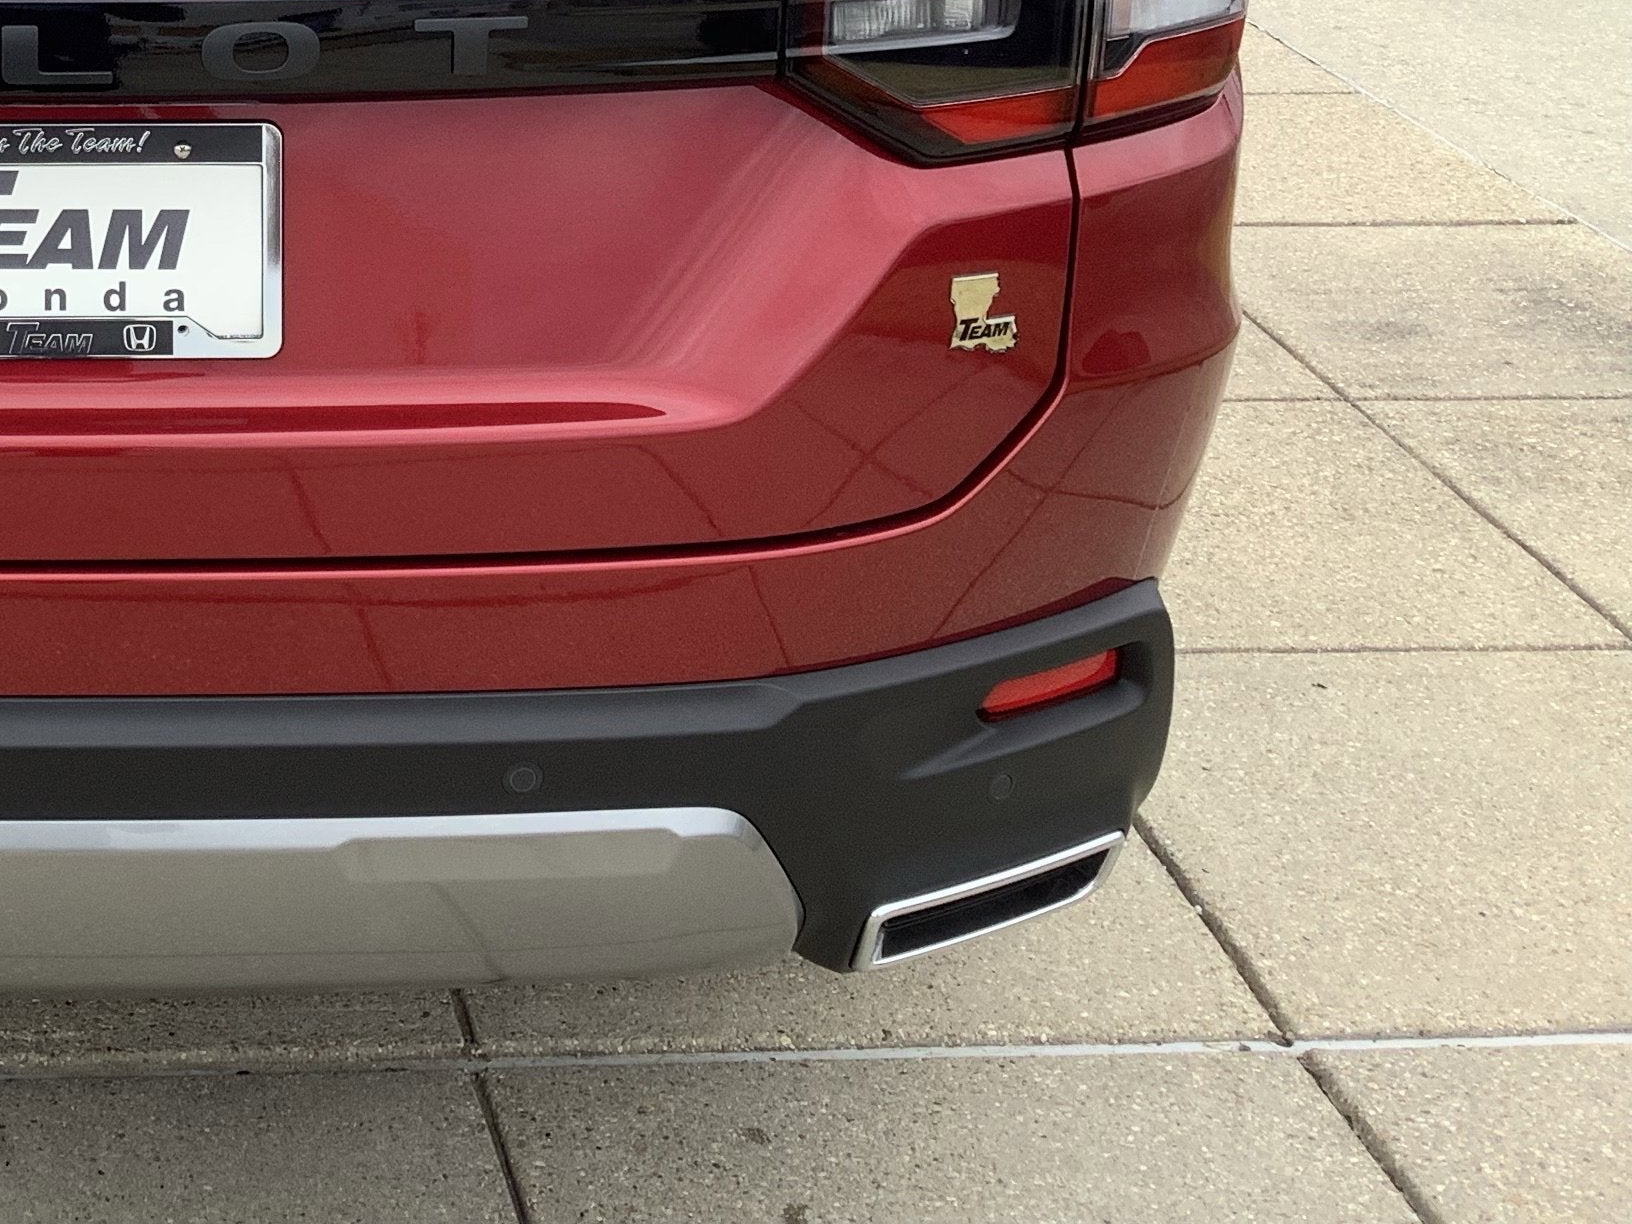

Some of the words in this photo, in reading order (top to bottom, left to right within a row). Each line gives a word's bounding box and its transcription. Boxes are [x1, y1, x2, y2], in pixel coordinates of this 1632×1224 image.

[12, 127, 64, 155] The
[65, 127, 151, 155] Team!
[5, 322, 94, 354] TEAM
[959, 317, 1011, 342] TEAM
